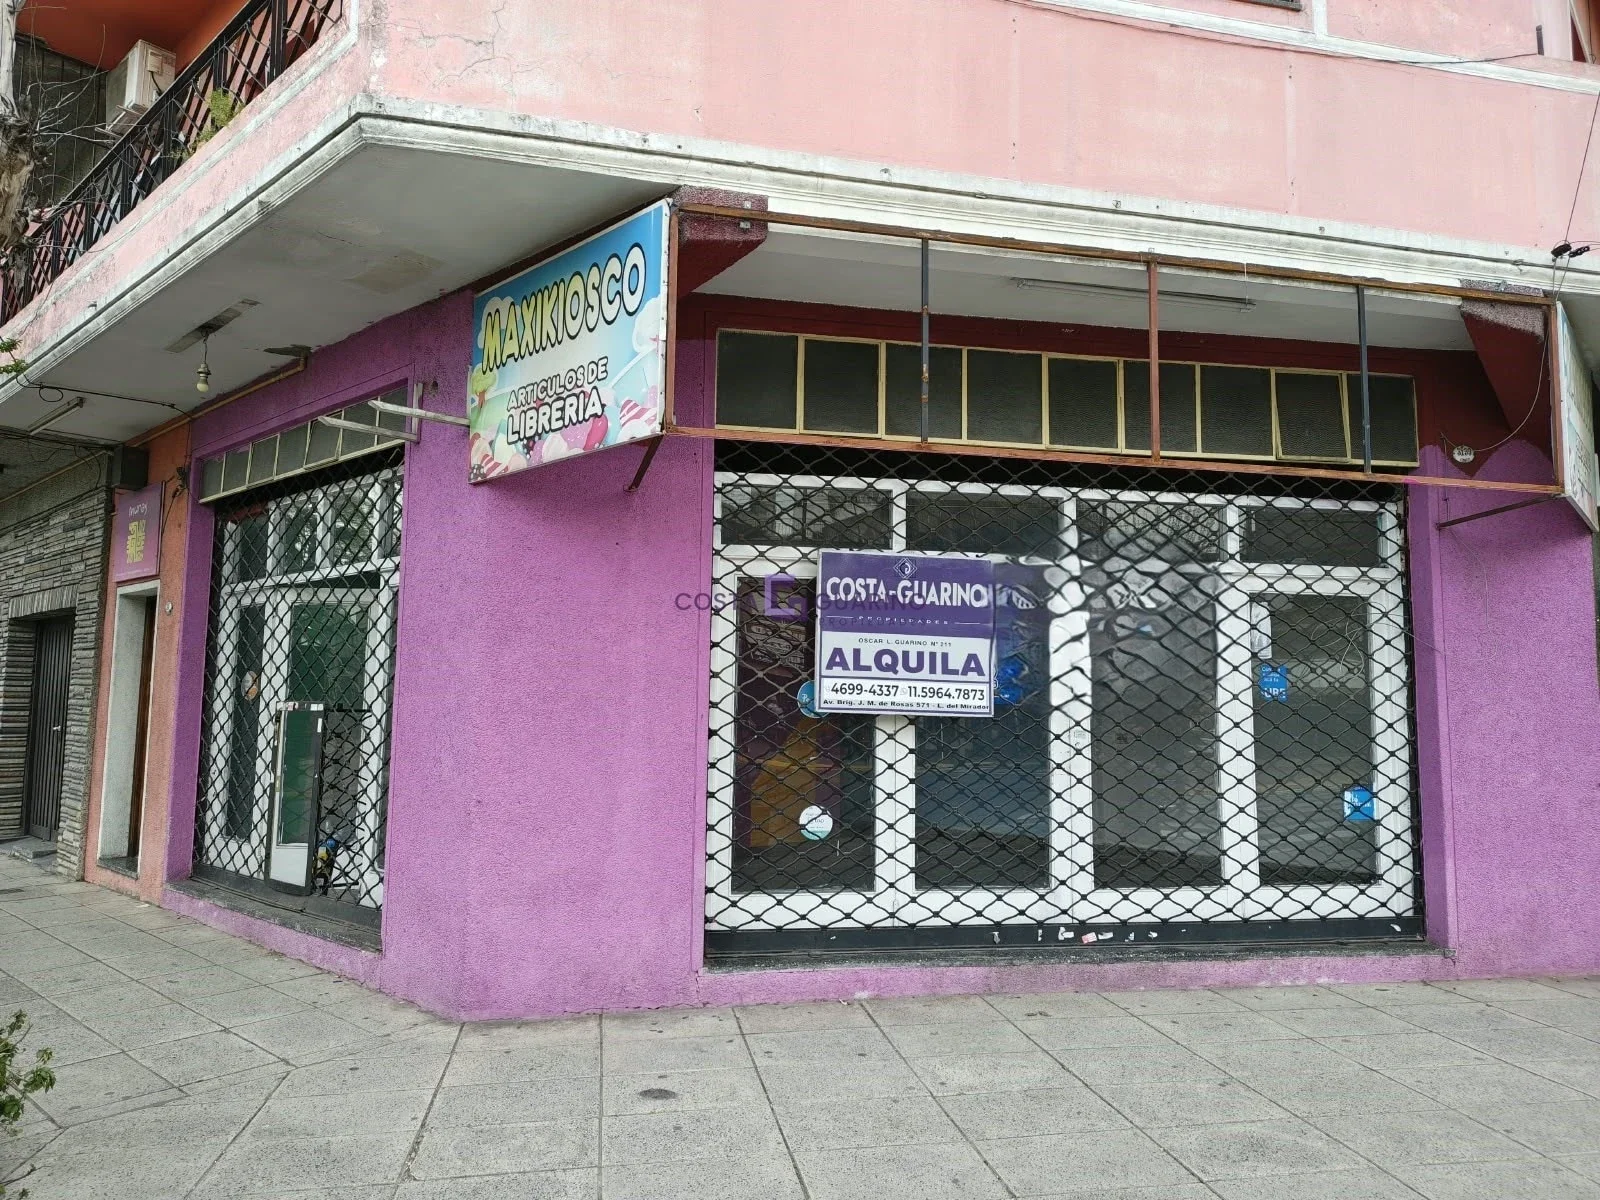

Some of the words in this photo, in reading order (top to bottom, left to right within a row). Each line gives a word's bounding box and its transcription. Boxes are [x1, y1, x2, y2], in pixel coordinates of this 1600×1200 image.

[481, 242, 647, 375] MAXIKIOSCO
[506, 363, 586, 411] ARTICULOS
[587, 356, 608, 383] DE
[506, 386, 606, 445] LIBRERIA
[826, 577, 989, 607] COSTA-GUARINO
[858, 615, 949, 625] PROPIEDADES
[825, 647, 986, 677] ALQUILA
[831, 683, 899, 697] 4699-4337
[907, 685, 985, 701] 11.5964.7873
